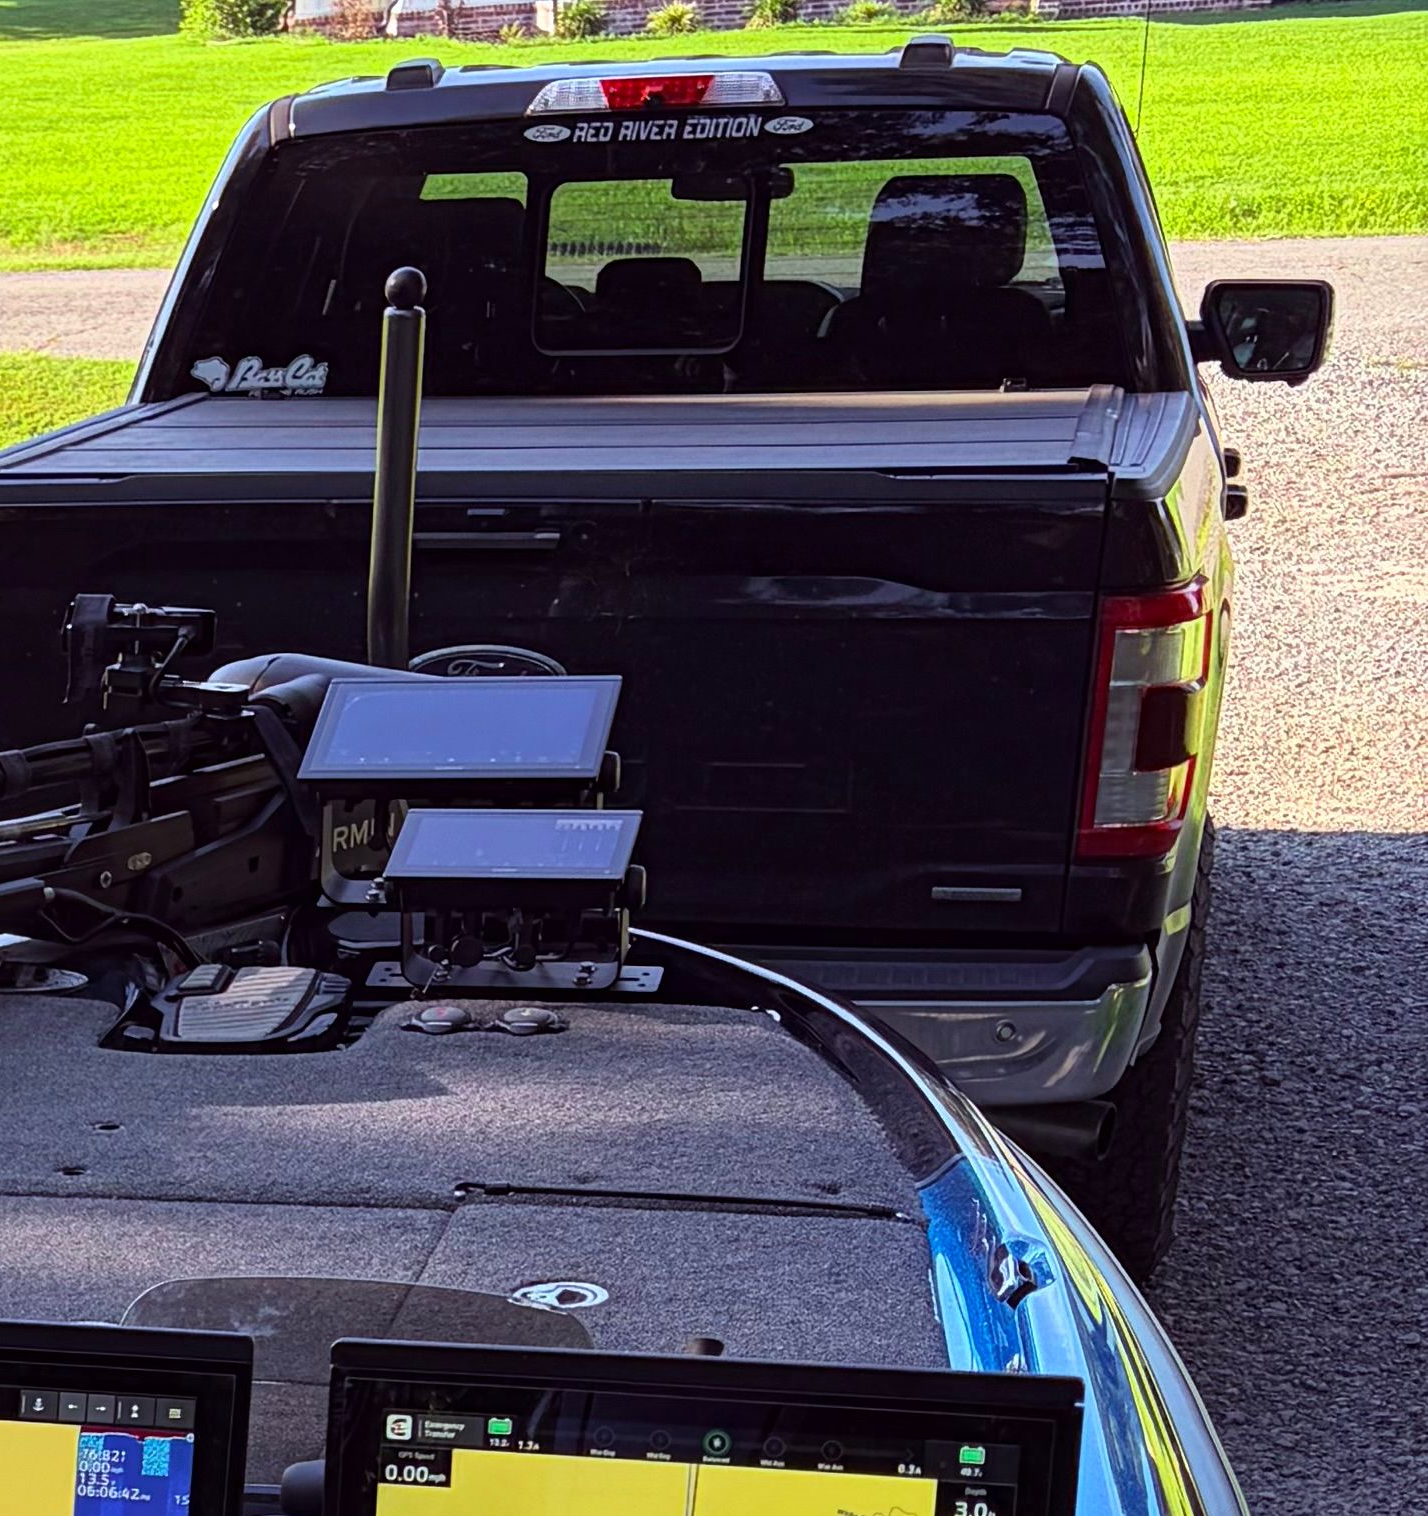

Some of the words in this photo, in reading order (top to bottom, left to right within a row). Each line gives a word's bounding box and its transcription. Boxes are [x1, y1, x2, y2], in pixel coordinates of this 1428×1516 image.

[572, 122, 614, 143] RED
[618, 119, 678, 142] RIVER
[682, 113, 763, 139] EDITION
